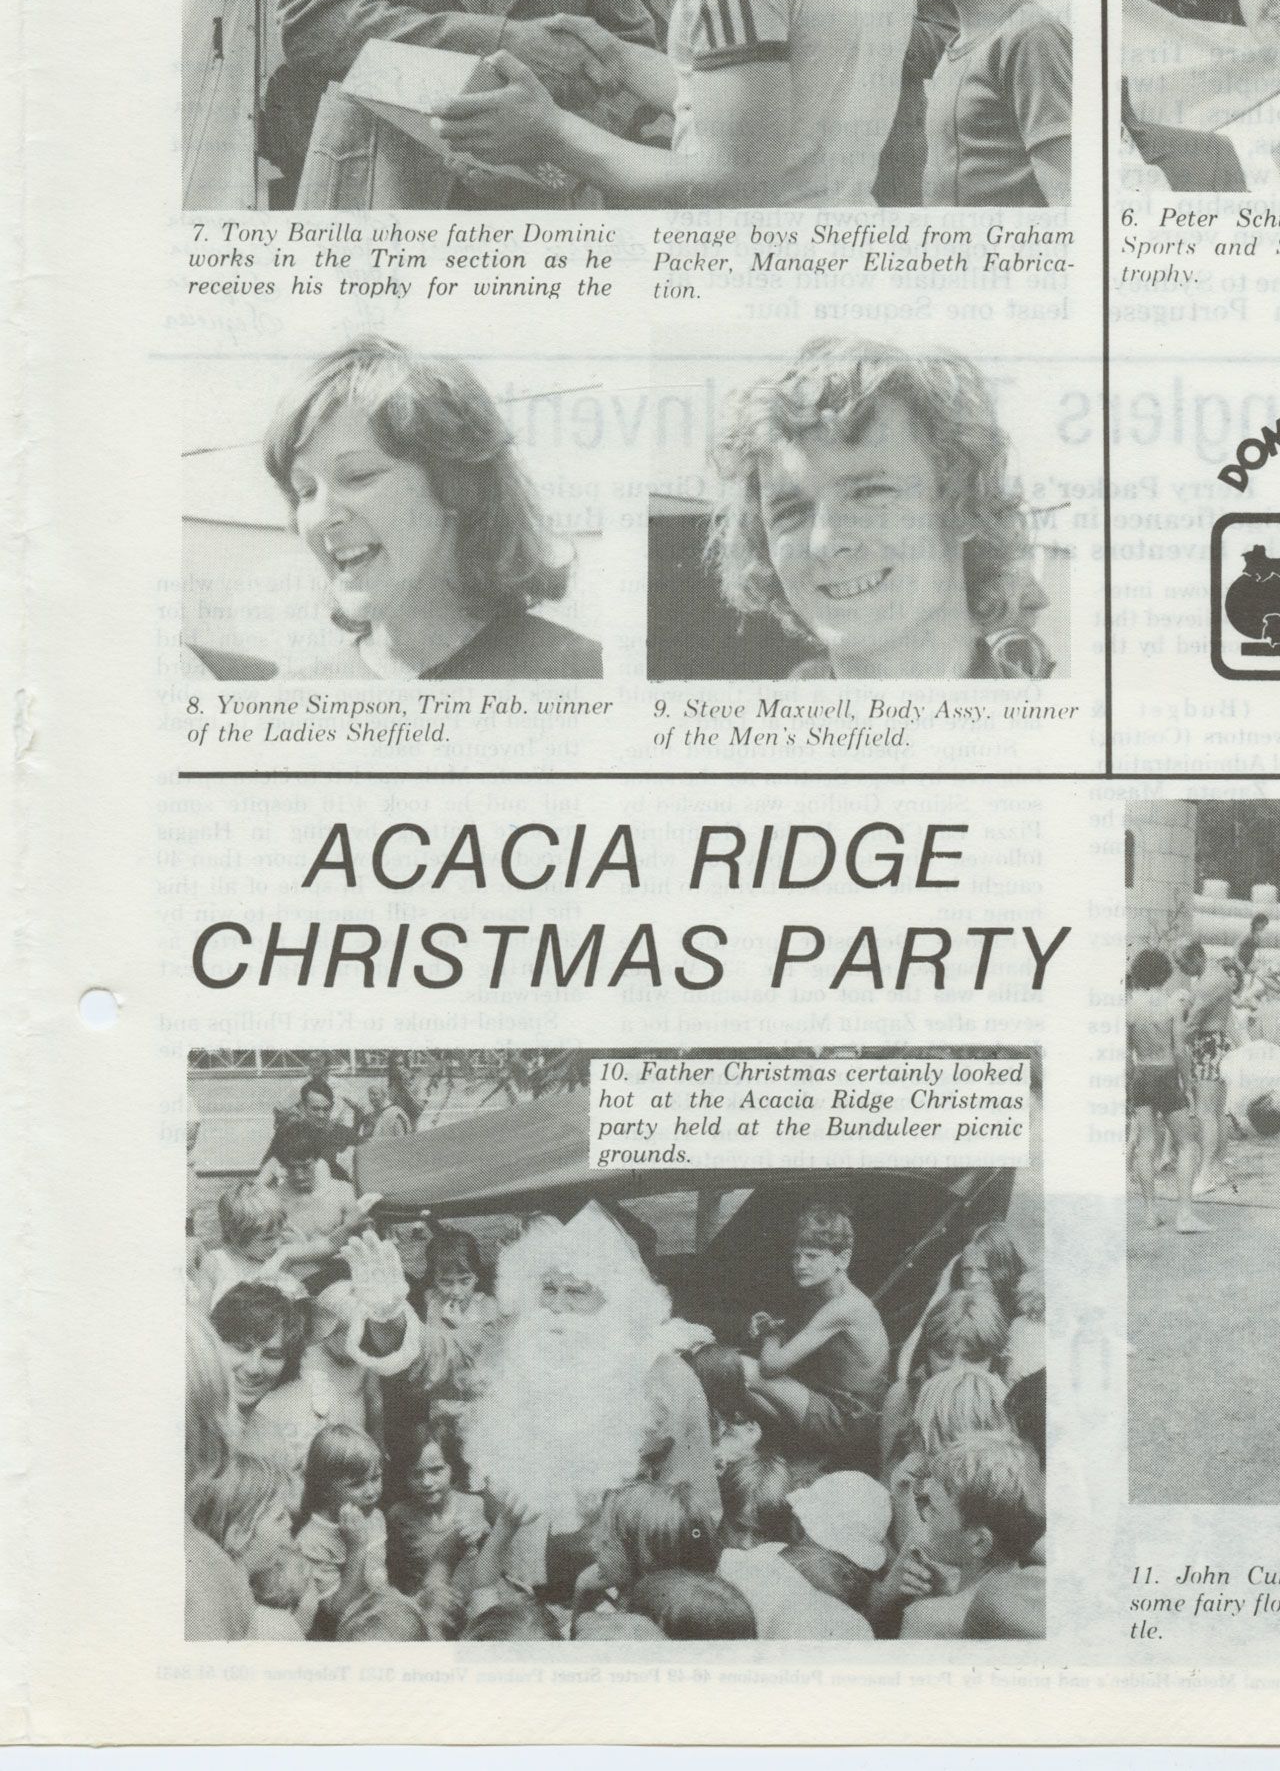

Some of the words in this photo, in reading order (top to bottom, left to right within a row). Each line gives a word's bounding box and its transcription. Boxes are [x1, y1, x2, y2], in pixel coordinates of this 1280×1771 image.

[1121, 208, 1138, 226] 6.
[1159, 207, 1219, 227] Peter
[222, 222, 278, 247] Tony
[288, 222, 362, 243] Barilla
[372, 222, 438, 242] whose
[446, 223, 514, 247] father
[523, 223, 616, 243] Dominic
[653, 227, 736, 246] teenage
[750, 224, 797, 244] boys
[811, 224, 910, 248] Sheffield
[921, 224, 971, 248] from
[986, 225, 1073, 245] Graham
[186, 696, 204, 715] 8.
[218, 695, 299, 715] Yvonne
[306, 694, 407, 719] Simpson,
[418, 694, 471, 714] Trim
[481, 694, 528, 715] Fab.
[538, 695, 613, 715] winner
[653, 699, 670, 718] 9.
[683, 699, 745, 719] Steve
[756, 698, 855, 720] Maxwell,
[869, 699, 925, 724] Body
[934, 700, 997, 723] Assy.
[1004, 699, 1079, 719] winner
[187, 722, 210, 746] of
[218, 722, 253, 743] the
[264, 722, 336, 742] Ladies
[346, 722, 451, 746] Sheffield.
[301, 823, 640, 890] ACACIA
[690, 822, 968, 889] RIDGE
[193, 922, 727, 990] CHRISTMAS
[771, 925, 1071, 990] PARTY
[601, 1062, 628, 1081] 10.
[639, 1061, 715, 1082] Father
[724, 1061, 837, 1082] Christmas
[846, 1062, 944, 1087] certainly
[952, 1061, 1024, 1082] looked
[599, 1088, 634, 1109] hot
[650, 1091, 673, 1109] at
[689, 1088, 725, 1109] the
[739, 1088, 814, 1109] Acacia
[831, 1089, 894, 1113] Ridge
[910, 1088, 1024, 1110] Christmas
[1132, 1566, 1159, 1585] 11.
[1175, 1564, 1230, 1585] John
